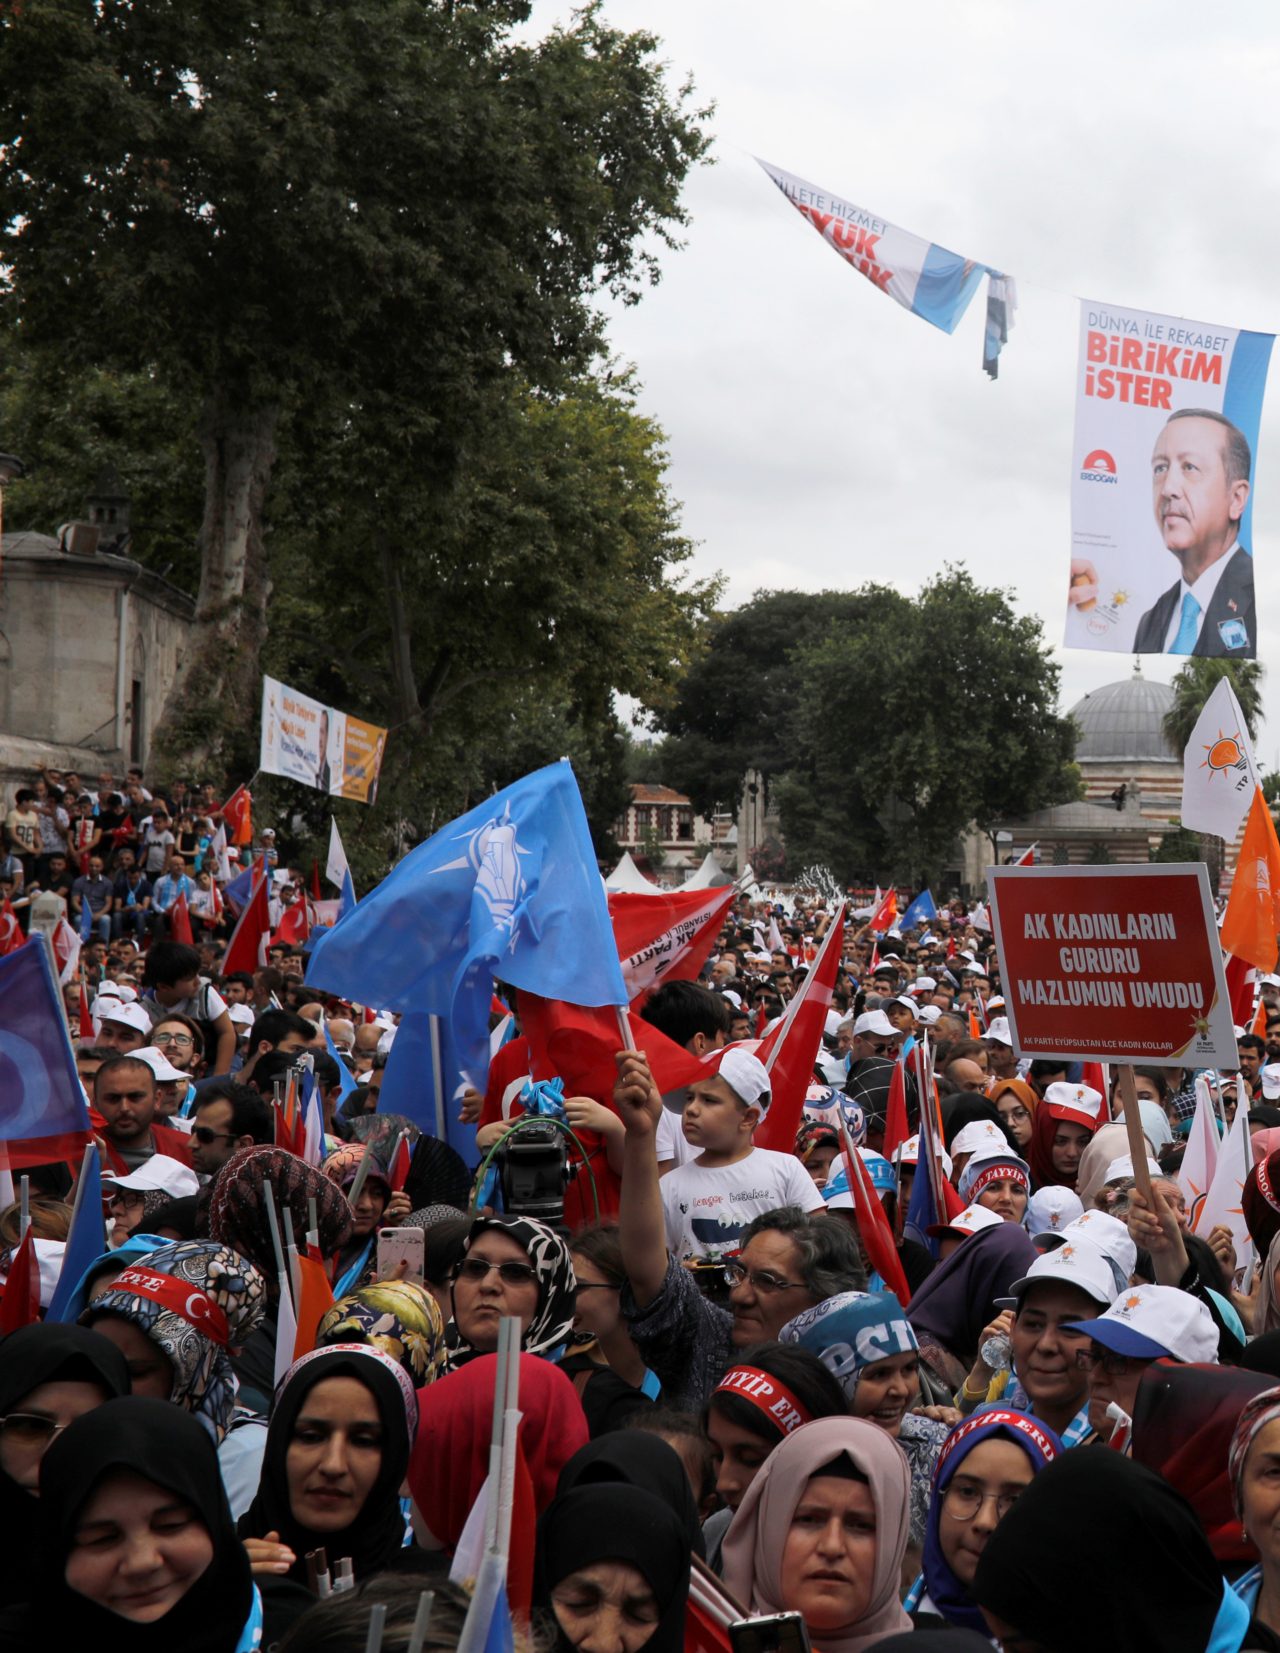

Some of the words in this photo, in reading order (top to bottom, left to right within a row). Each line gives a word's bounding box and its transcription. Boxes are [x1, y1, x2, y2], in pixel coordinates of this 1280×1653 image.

[1088, 311, 1139, 336] DÜNYA
[1145, 319, 1164, 340] İLE
[1168, 328, 1229, 352] REKABET
[1087, 330, 1222, 385] BİRİKİM
[1085, 365, 1172, 411] İSTER
[676, 928, 696, 946] AK
[1024, 913, 1050, 939] AK
[1052, 913, 1176, 940] KADINLARIN
[629, 940, 672, 969] PARTİ
[1018, 979, 1127, 1008] MAZLUMUN
[1129, 982, 1204, 1009] UMUDU
[1024, 1037, 1033, 1045] AK
[1054, 1037, 1101, 1047] EYÜPSULTAN
[1118, 1041, 1141, 1049] KADIN
[1142, 1042, 1173, 1050] KOLLARI
[985, 1166, 1024, 1184] TAYYİP
[1015, 1419, 1055, 1462] ERD
